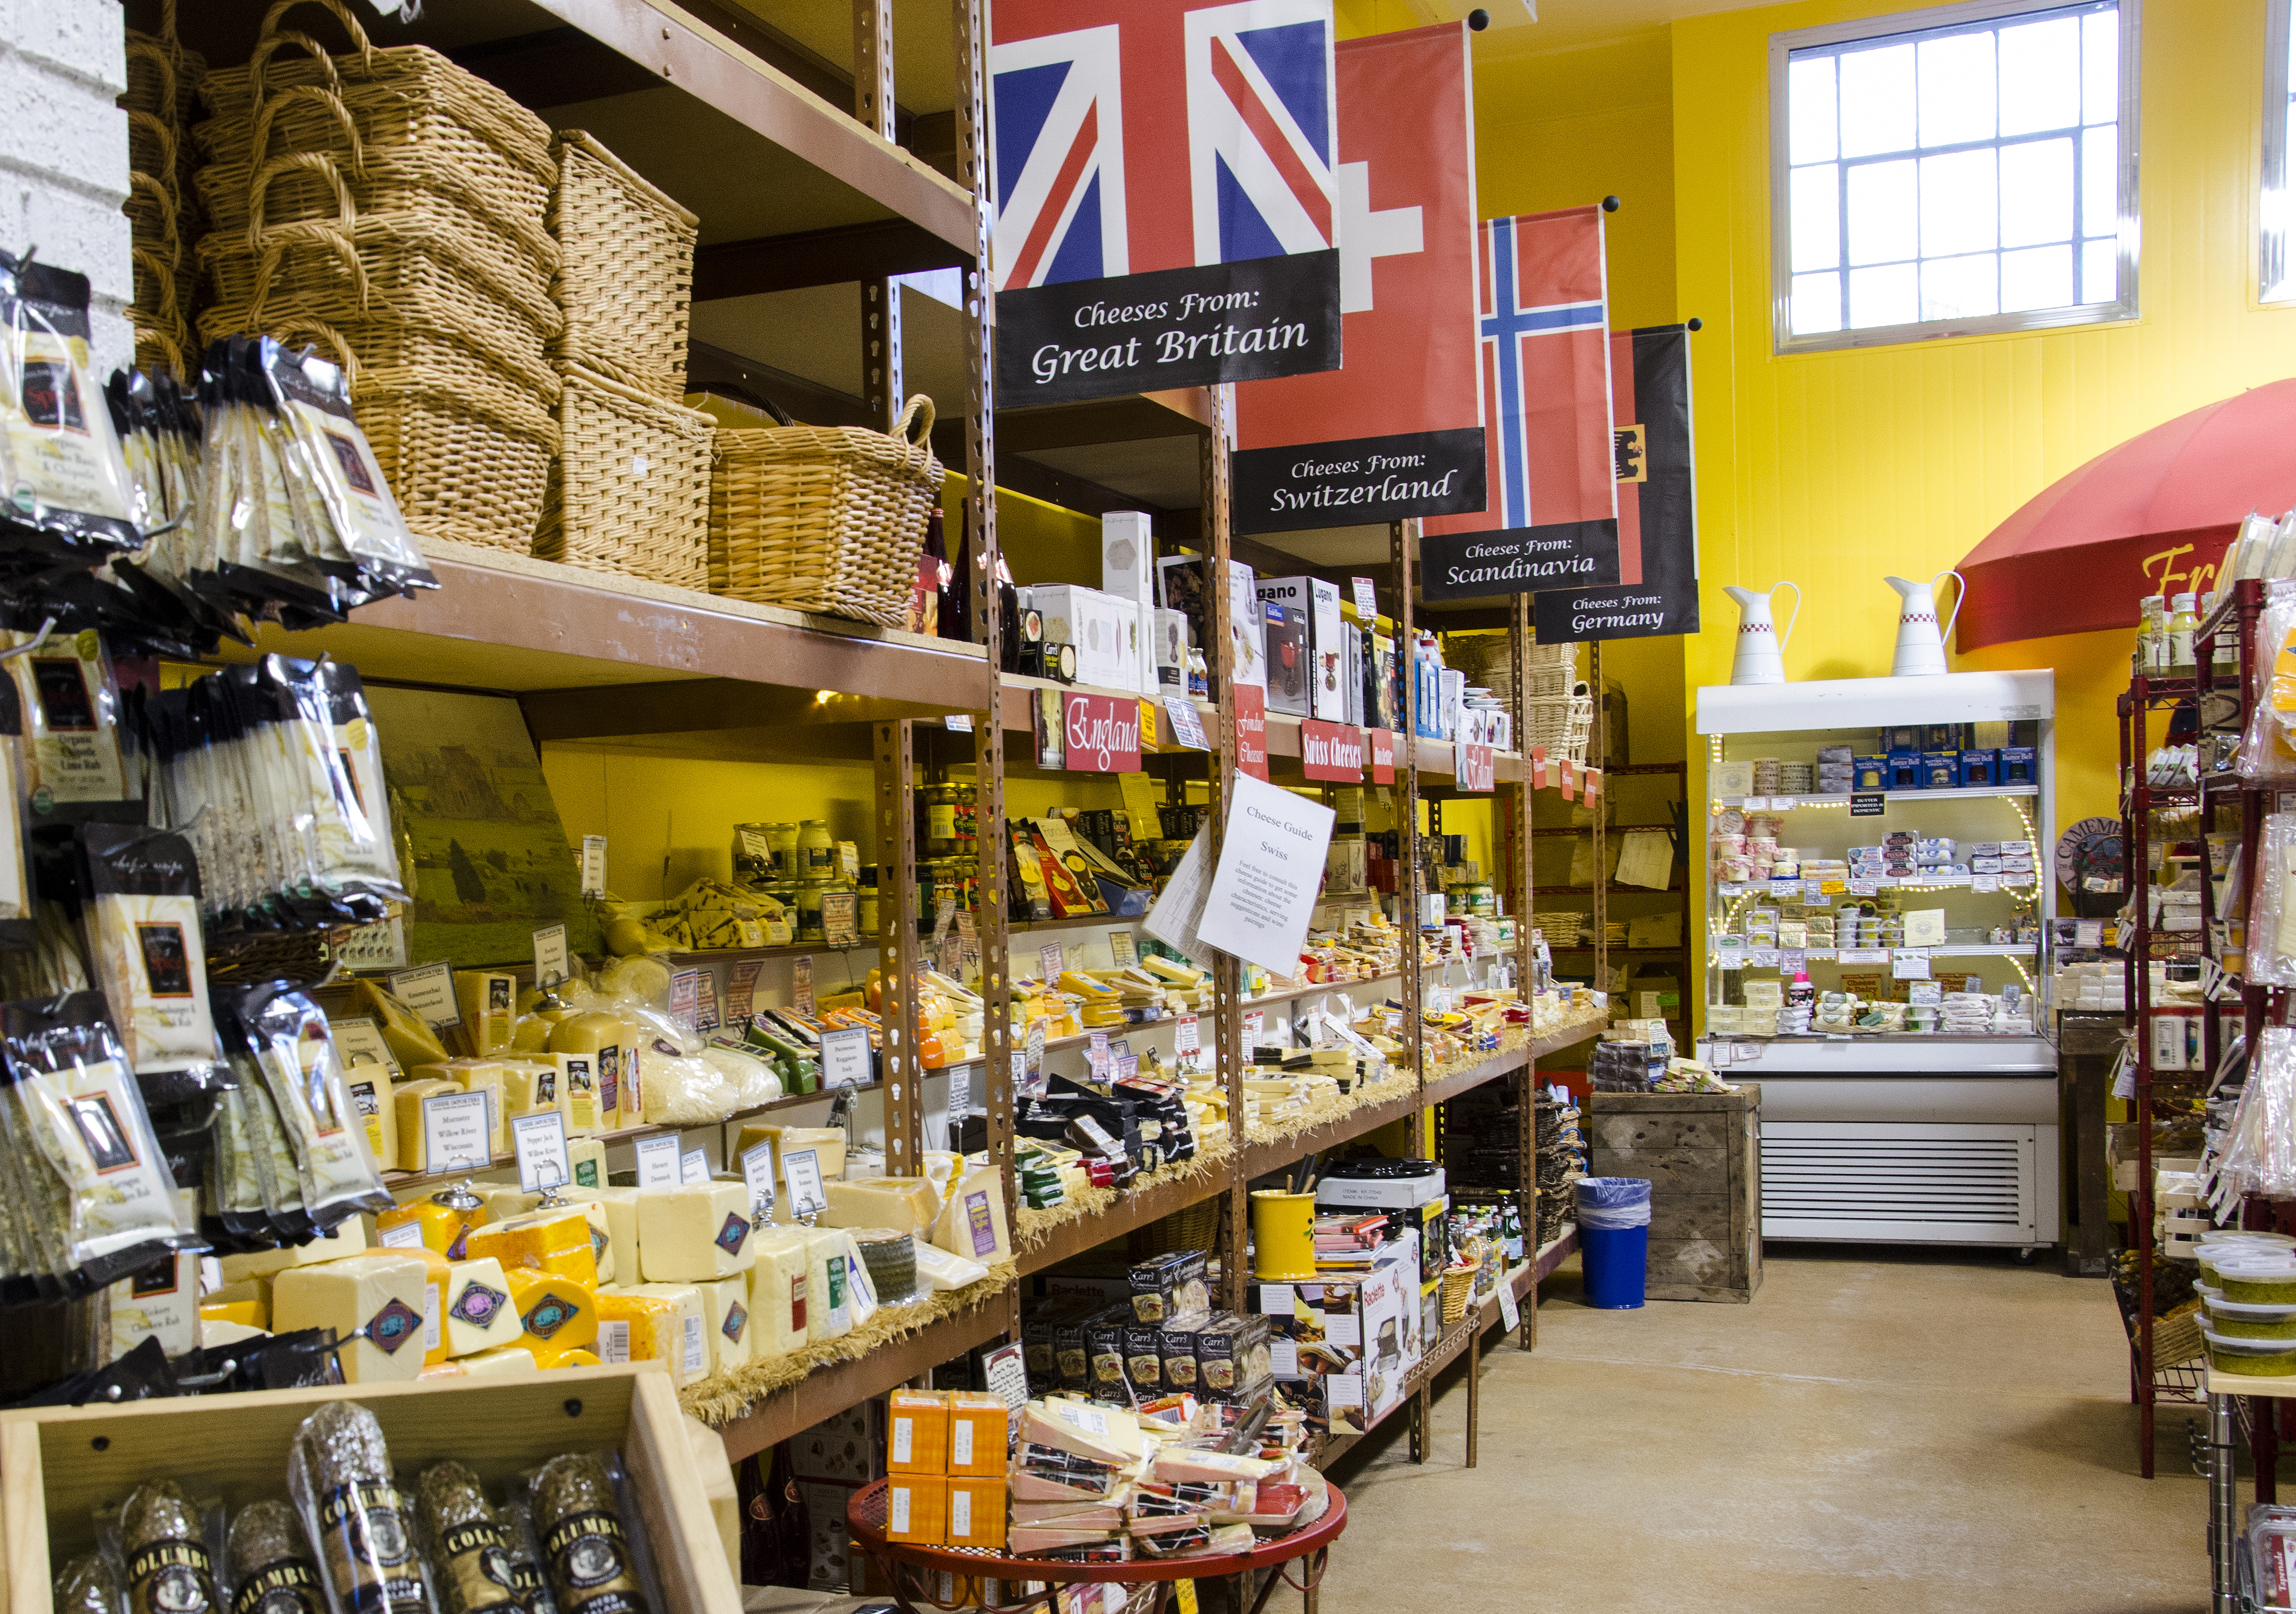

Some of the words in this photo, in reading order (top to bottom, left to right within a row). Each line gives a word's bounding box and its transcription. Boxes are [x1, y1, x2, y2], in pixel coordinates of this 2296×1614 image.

[1075, 301, 1168, 328] Cheeses
[1176, 291, 1260, 321] From:
[1032, 337, 1142, 384] Great
[1156, 317, 1308, 363] Britain
[1292, 461, 1359, 478] Cheeses
[1365, 454, 1426, 474] From:
[1270, 464, 1458, 511] Switzerland
[1466, 543, 1520, 558] Cheeses
[1524, 539, 1572, 556] From:
[1446, 554, 1596, 585] Scandinavia
[2142, 543, 2215, 595] Fr
[1257, 586, 1296, 599] gano
[1314, 584, 1332, 603] Lugano
[1573, 598, 1618, 610] Cheeses
[1621, 596, 1661, 609] From:
[1572, 612, 1664, 633] Germany
[1067, 697, 1139, 771] England
[1240, 742, 1264, 764] Cheeses
[1304, 733, 1328, 765] Swiss
[1331, 737, 1362, 768] Cheeses
[1041, 825, 1071, 838] Fondue
[1247, 806, 1281, 828] Cheese
[1284, 822, 1313, 841] Guide
[1261, 841, 1288, 861] Swiss
[1235, 868, 1252, 879] cheese
[1253, 877, 1268, 885] guide
[1284, 890, 1297, 898] some
[1239, 860, 1251, 870] Feel
[1252, 865, 1262, 874] free
[1269, 874, 1287, 885] consult
[1288, 882, 1297, 890] this
[1237, 876, 1267, 894] information
[1268, 891, 1282, 900] about
[1264, 898, 1282, 909] cheese
[1230, 902, 1260, 917] suggestions
[1272, 919, 1284, 928] wine
[1244, 916, 1265, 929] pairings
[1270, 909, 1288, 922] serving
[1855, 986, 1878, 994] Dairy
[438, 1129, 460, 1138] Willow
[526, 1136, 542, 1145] Pepper
[544, 1133, 554, 1143] Jack
[528, 1149, 544, 1158] Willow
[1134, 1271, 1155, 1282] Carr's
[1364, 1282, 1385, 1309] Raclette
[1093, 1330, 1115, 1341] Carr's
[1129, 1332, 1151, 1343] Carr's
[1165, 1334, 1187, 1344] Carr's
[1202, 1336, 1225, 1347] Carr's
[1100, 1387, 1121, 1398] Carr's
[2274, 1551, 2288, 1592] Tapenade
